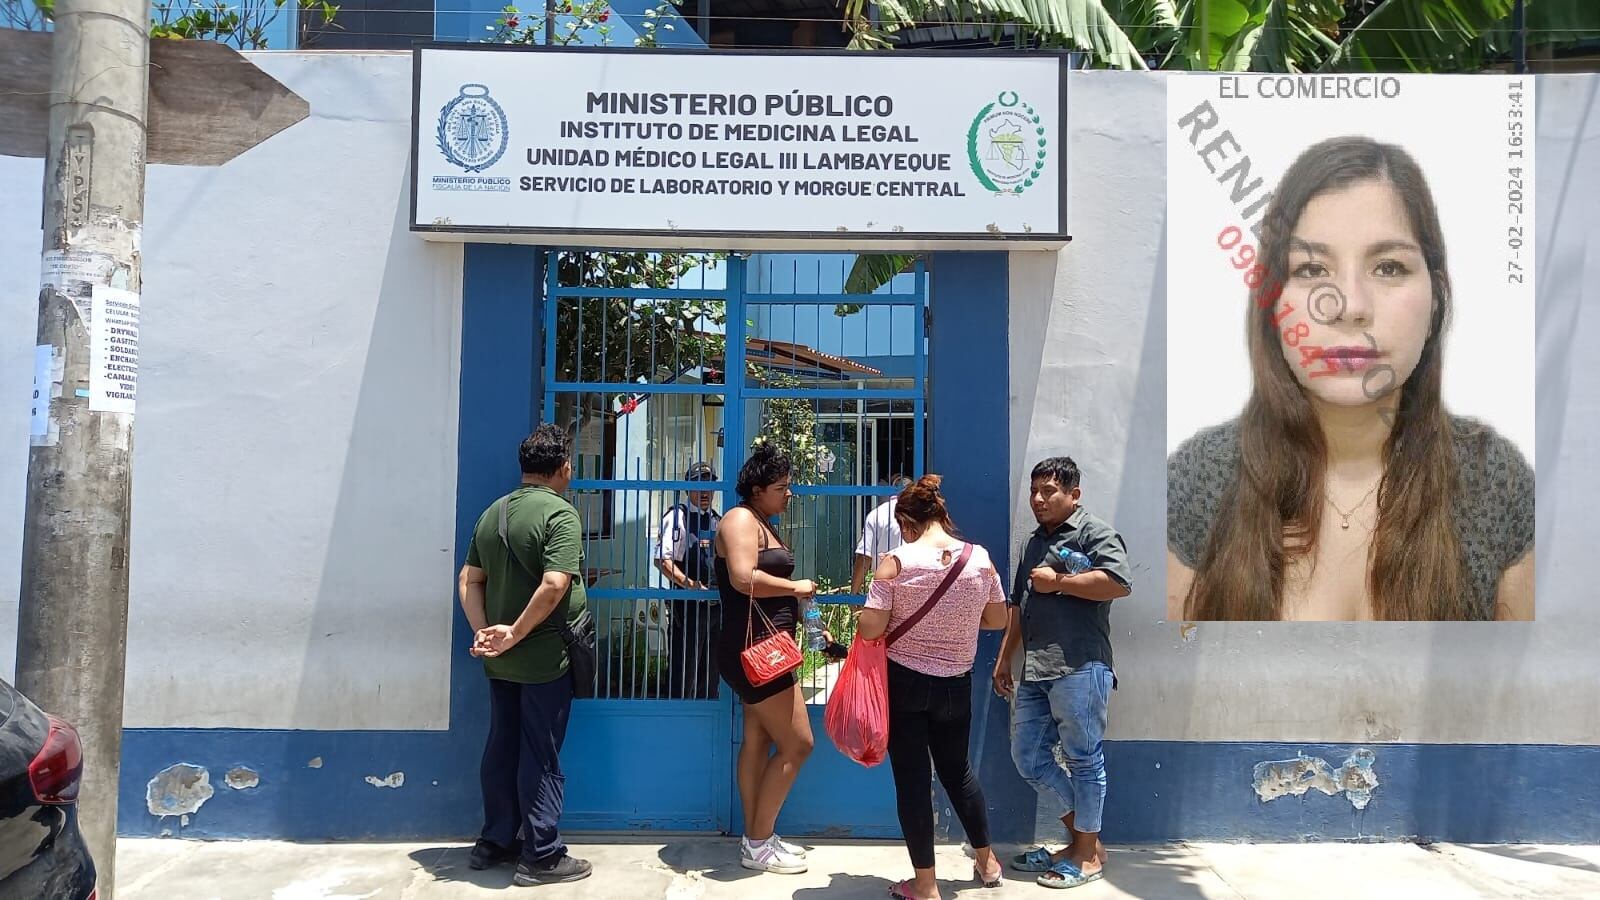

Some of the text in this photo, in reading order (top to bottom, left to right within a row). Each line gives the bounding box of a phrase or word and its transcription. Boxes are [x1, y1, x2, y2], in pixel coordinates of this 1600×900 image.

[586, 89, 893, 117] MINISTERIO PÚBLICO
[560, 121, 919, 143] INSTITUTO DE MEDICINA LEGAL
[526, 146, 951, 173] UNIDAD MÉDICO LEGAL III LAMBAYEQUE
[432, 177, 476, 185] MINISTERIO
[519, 175, 966, 197] SERVICIO DE LABORATORIO Y MORGUE CENTRAL
